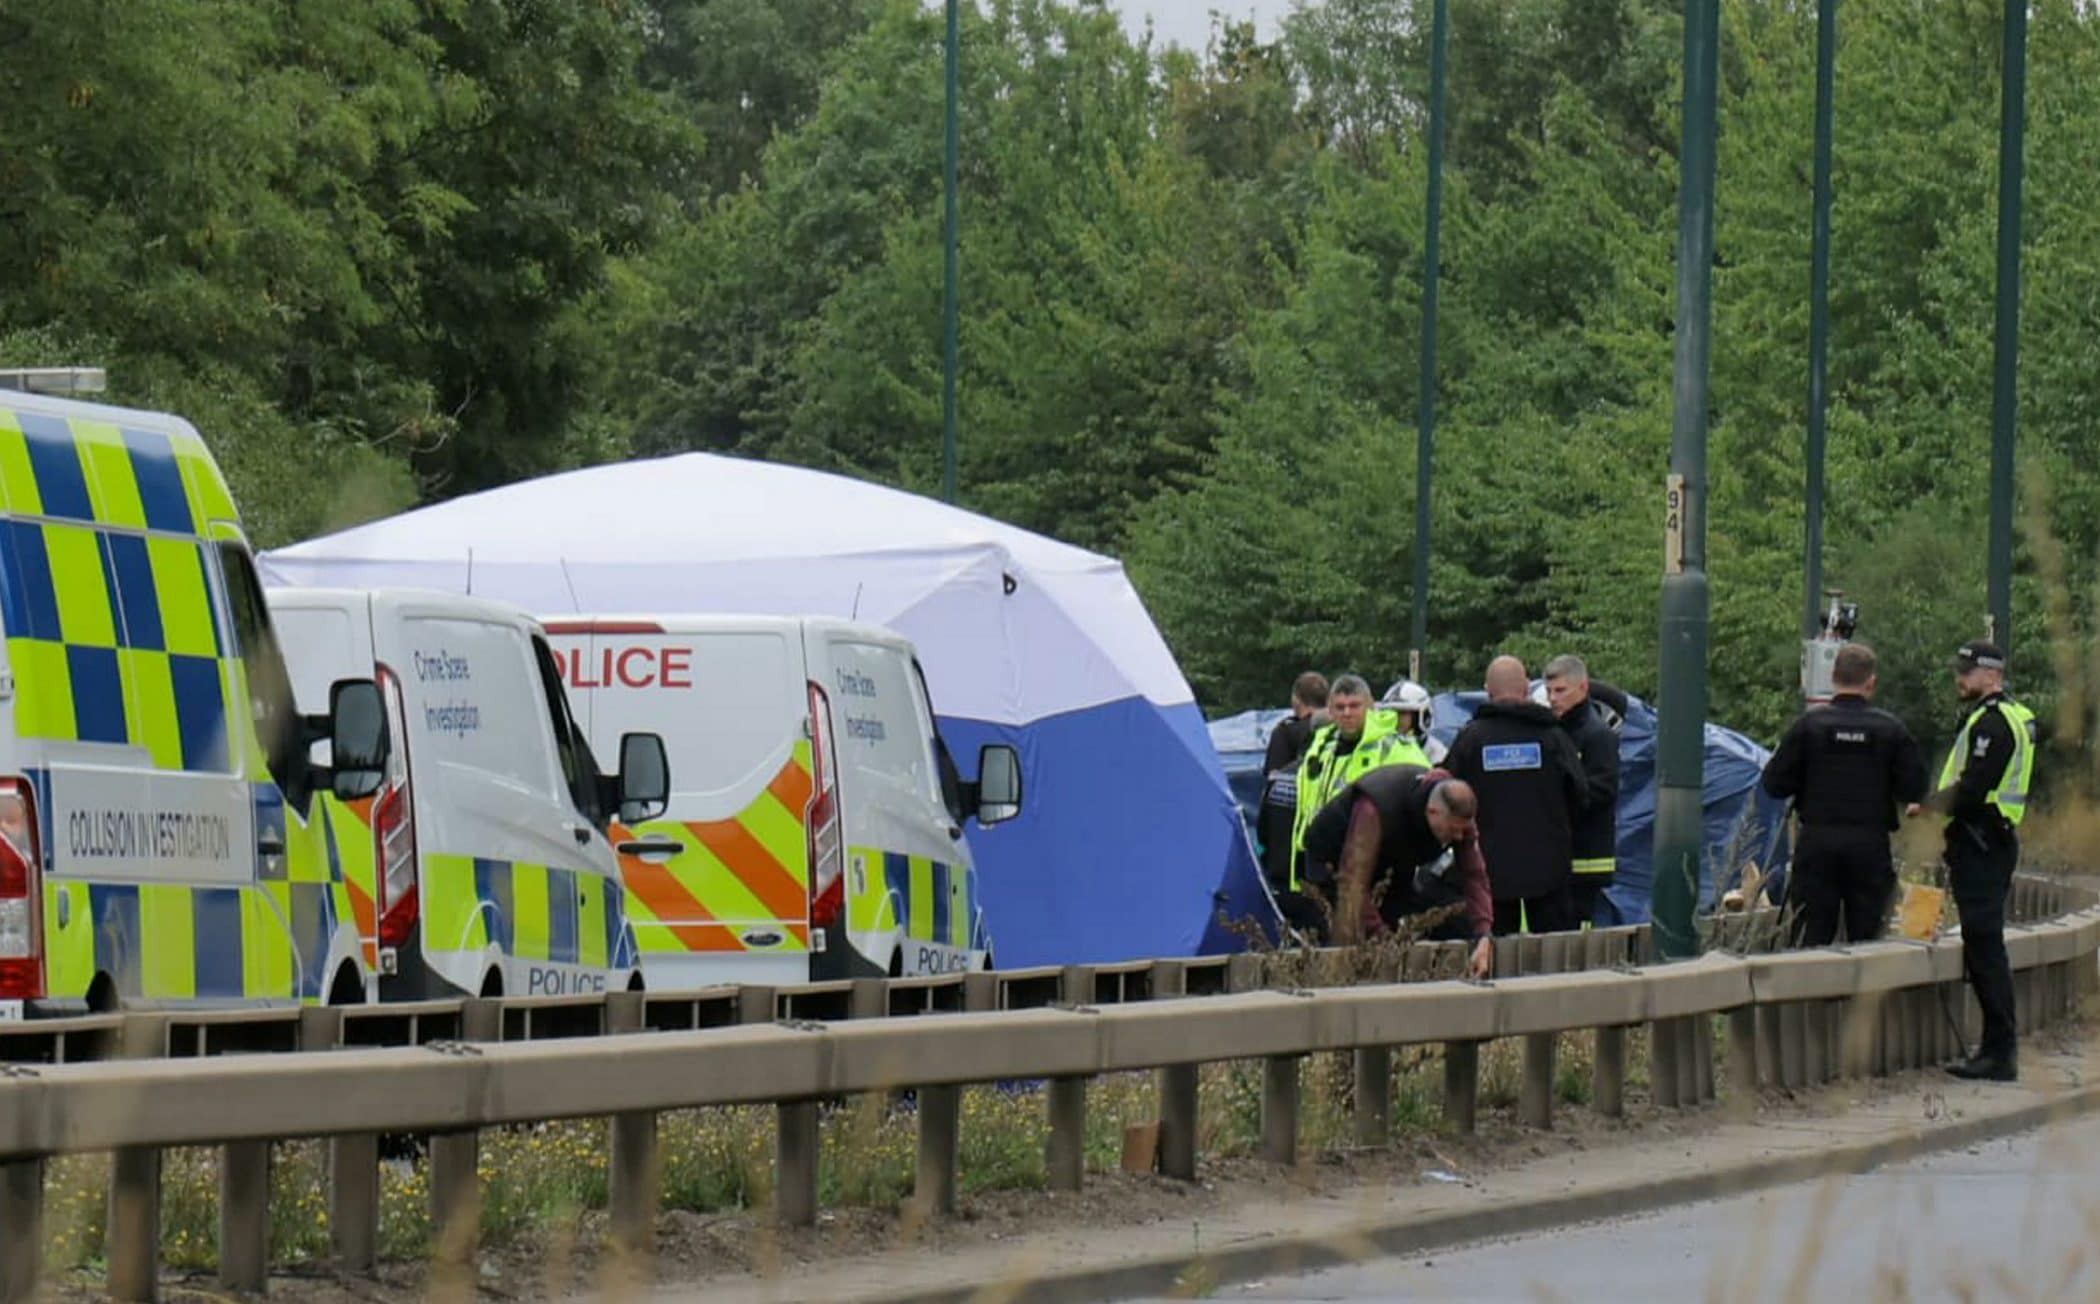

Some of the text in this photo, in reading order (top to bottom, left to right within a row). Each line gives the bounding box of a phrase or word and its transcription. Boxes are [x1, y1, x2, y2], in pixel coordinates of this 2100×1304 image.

[1667, 490, 1679, 532] 94
[69, 810, 230, 861] COLLISION INVESTIGATION
[528, 966, 606, 996] POLICE
